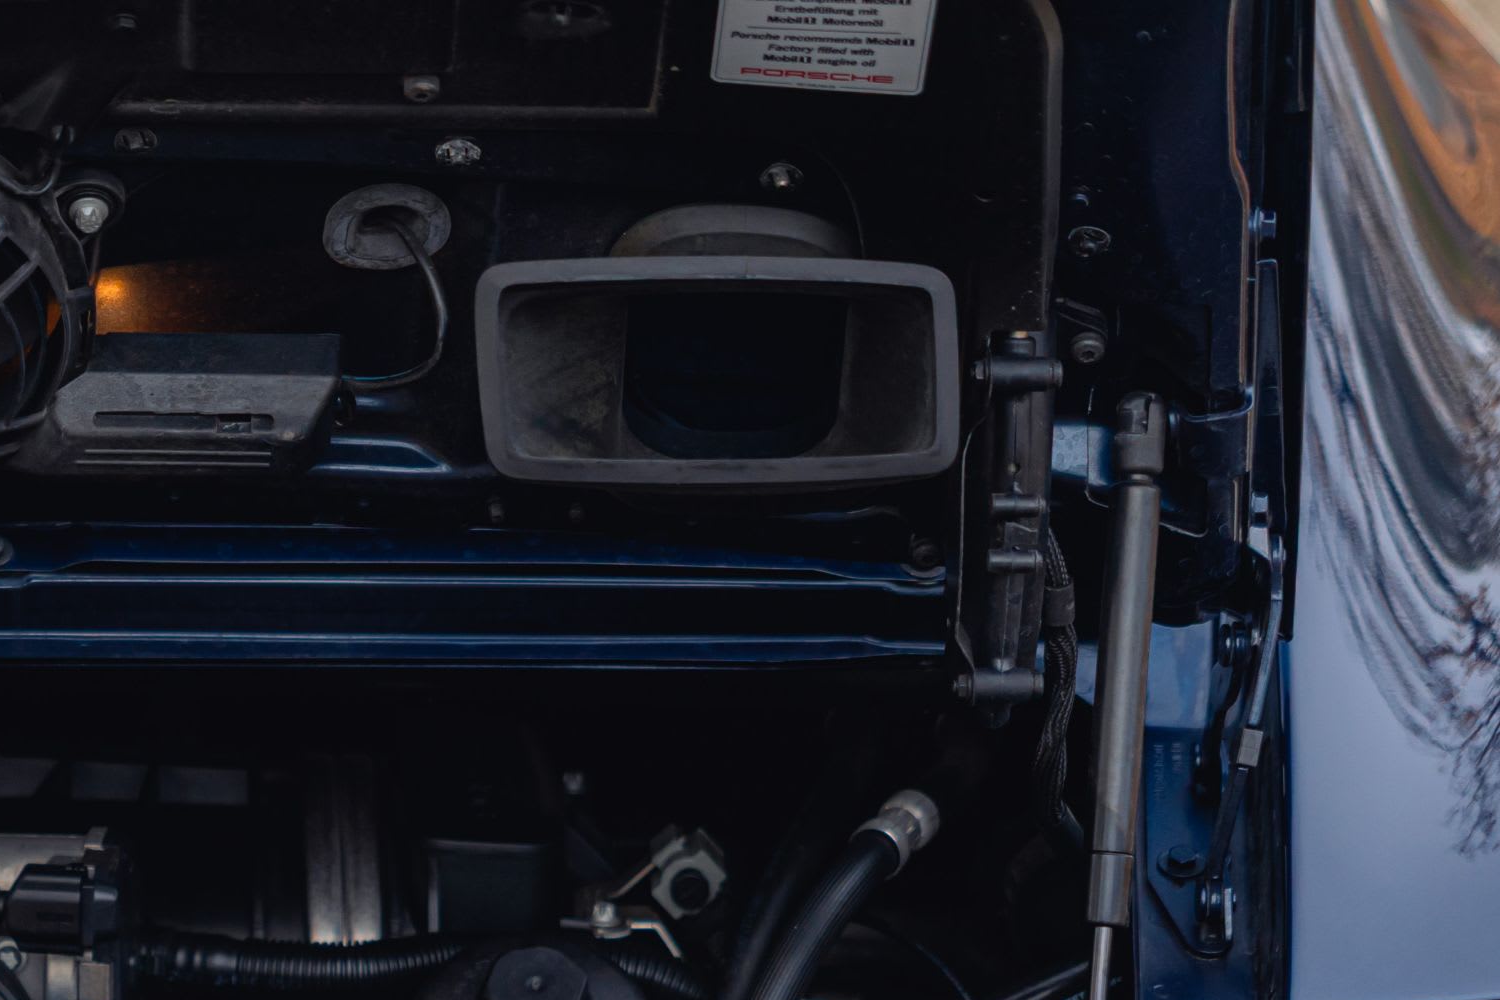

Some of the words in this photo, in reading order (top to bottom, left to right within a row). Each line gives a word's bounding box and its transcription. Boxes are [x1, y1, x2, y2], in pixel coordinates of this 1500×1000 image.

[775, 5, 854, 16] Erstbefüllung
[822, 18, 884, 27] Motorenöl
[731, 31, 781, 40] Porsche
[784, 35, 863, 44] recommends
[768, 44, 813, 54] Factory
[817, 47, 847, 55] filled
[740, 67, 894, 84] PORSCHE
